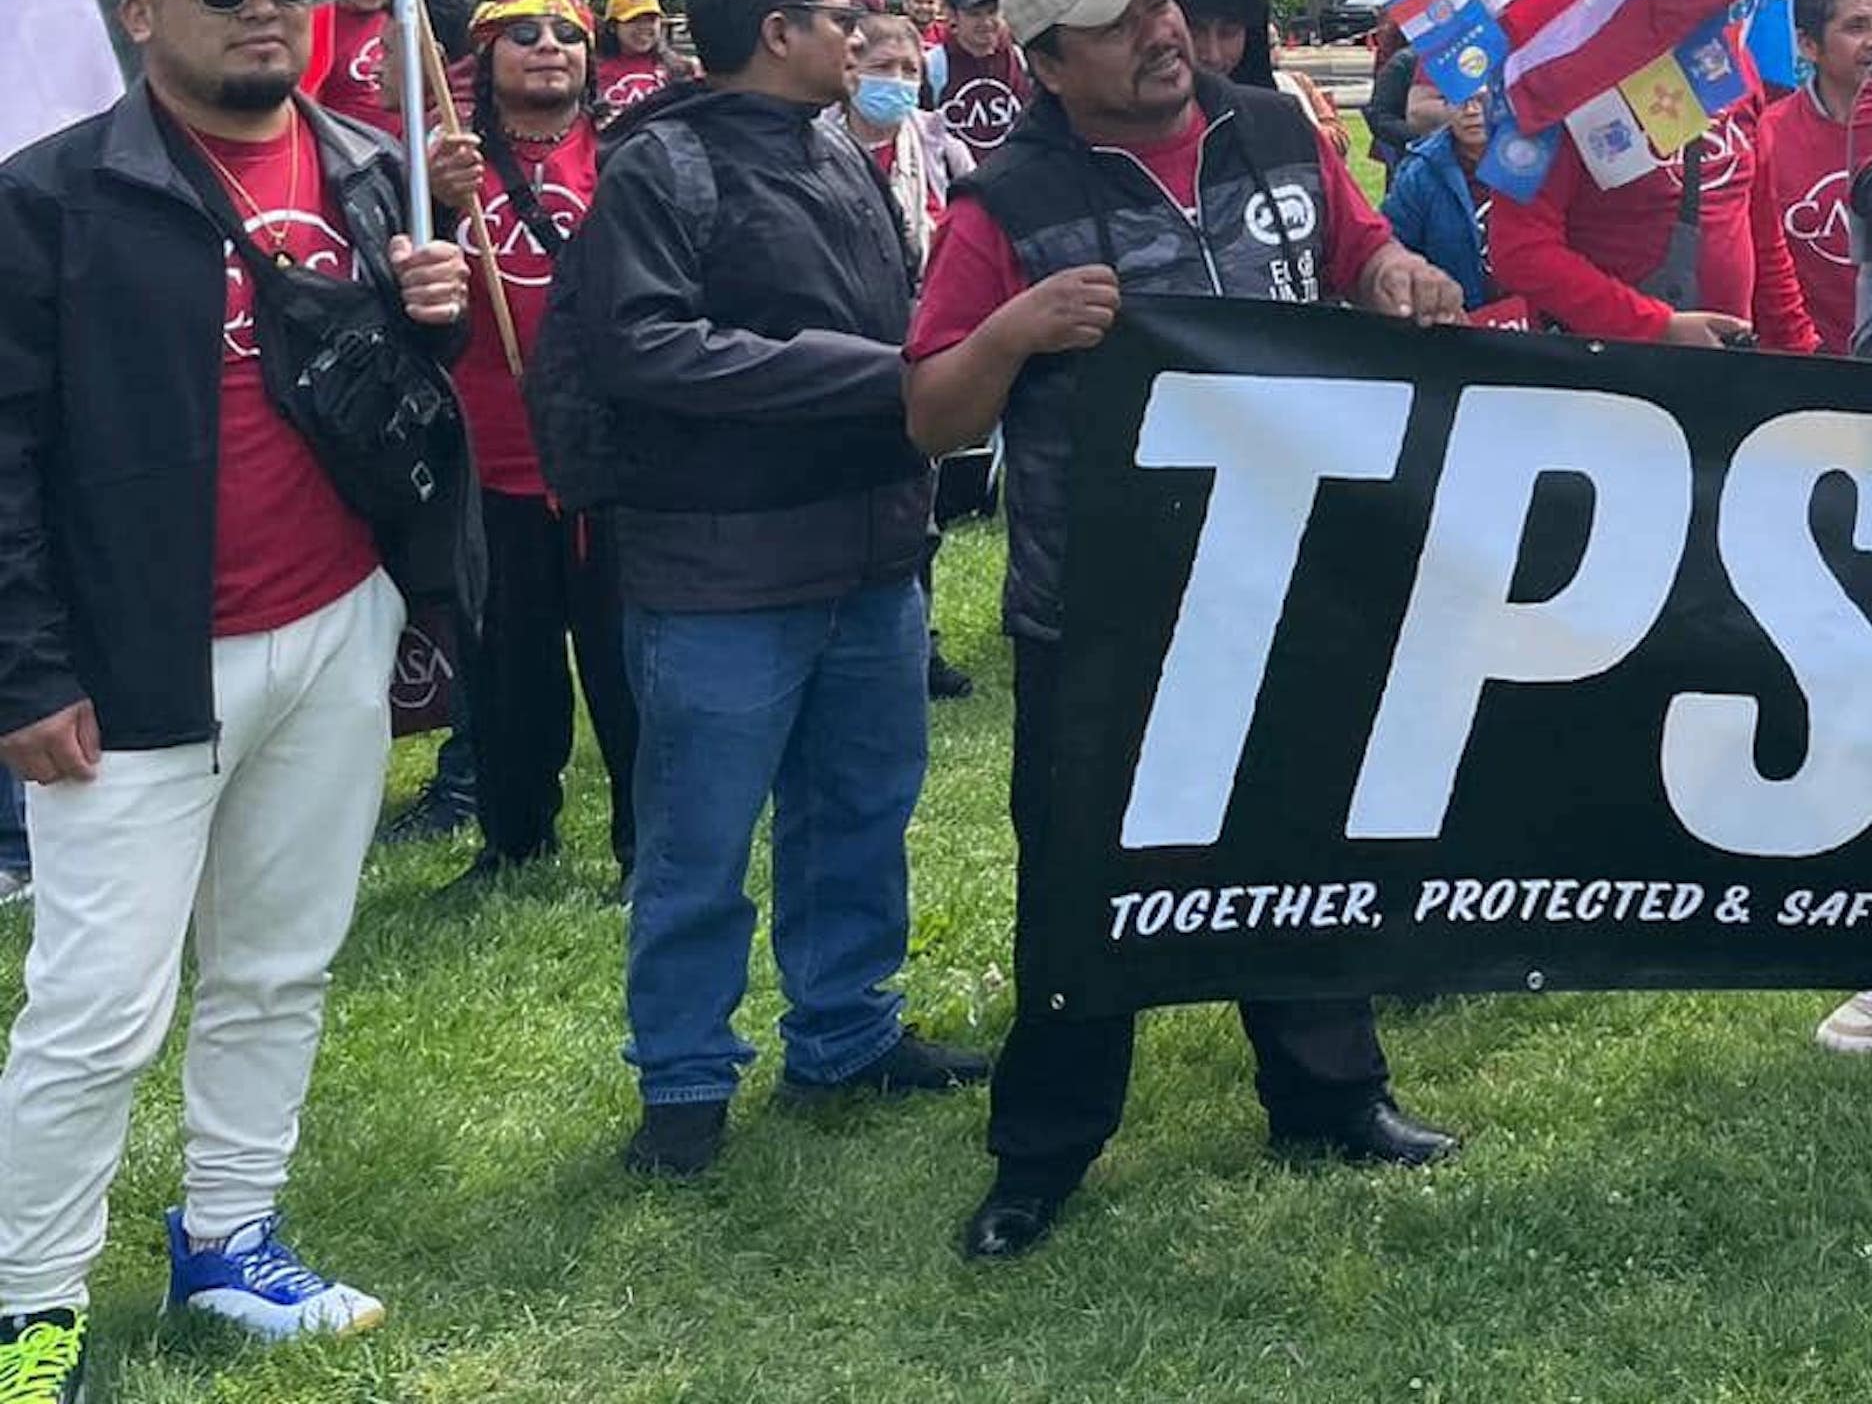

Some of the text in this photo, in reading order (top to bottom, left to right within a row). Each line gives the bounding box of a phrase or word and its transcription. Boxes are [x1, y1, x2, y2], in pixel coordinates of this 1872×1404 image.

[1108, 881, 1384, 940] TOGETHER,
[1413, 879, 1705, 924] PROTECTED
[1715, 885, 1752, 924] &
